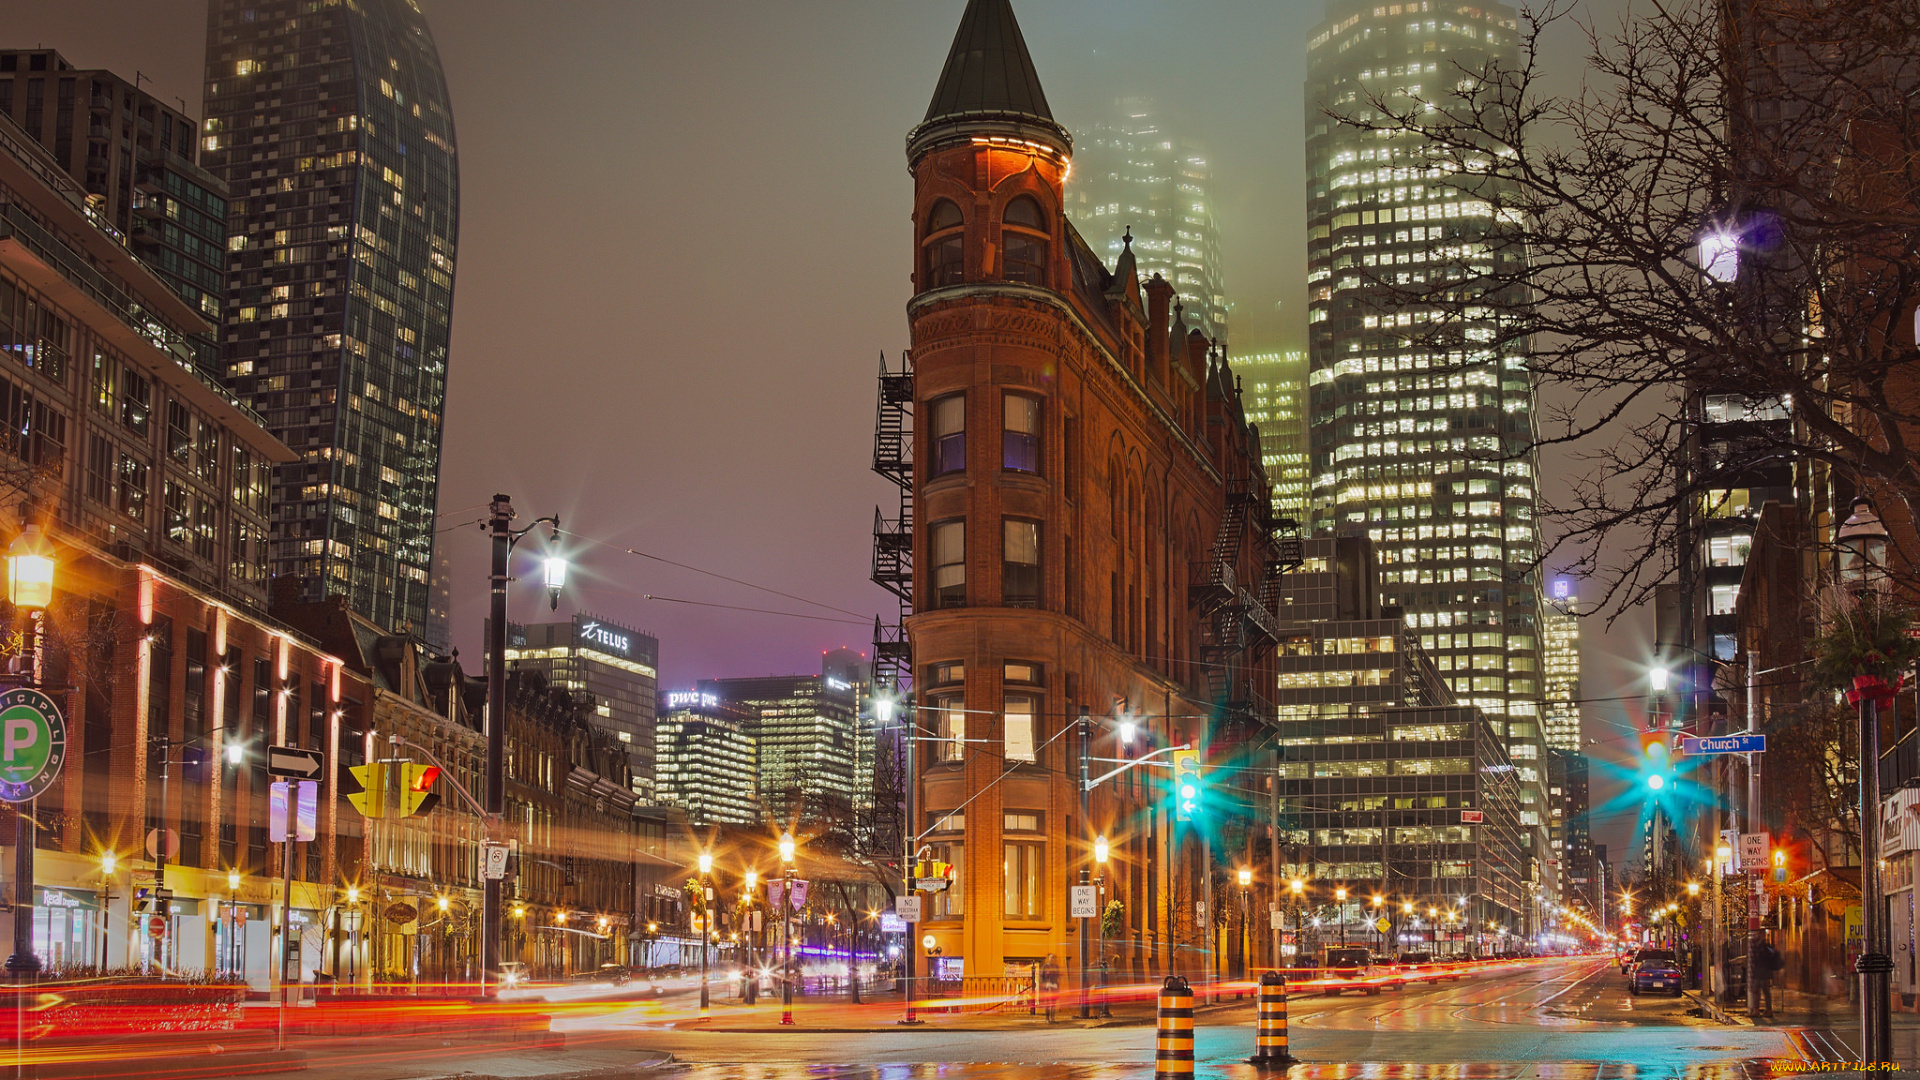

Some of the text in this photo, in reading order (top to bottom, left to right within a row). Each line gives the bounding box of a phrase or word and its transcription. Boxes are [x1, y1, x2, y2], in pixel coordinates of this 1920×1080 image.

[596, 629, 628, 651] TELUS
[669, 692, 700, 708] pwc
[3, 719, 38, 762] P
[1699, 738, 1740, 750] Church
[1747, 836, 1762, 845] ONE
[1747, 847, 1762, 855] WAY
[1741, 857, 1768, 866] BEGINS
[1077, 888, 1090, 896] ONE
[904, 899, 913, 907] NO
[1072, 907, 1095, 915] BEGINS
